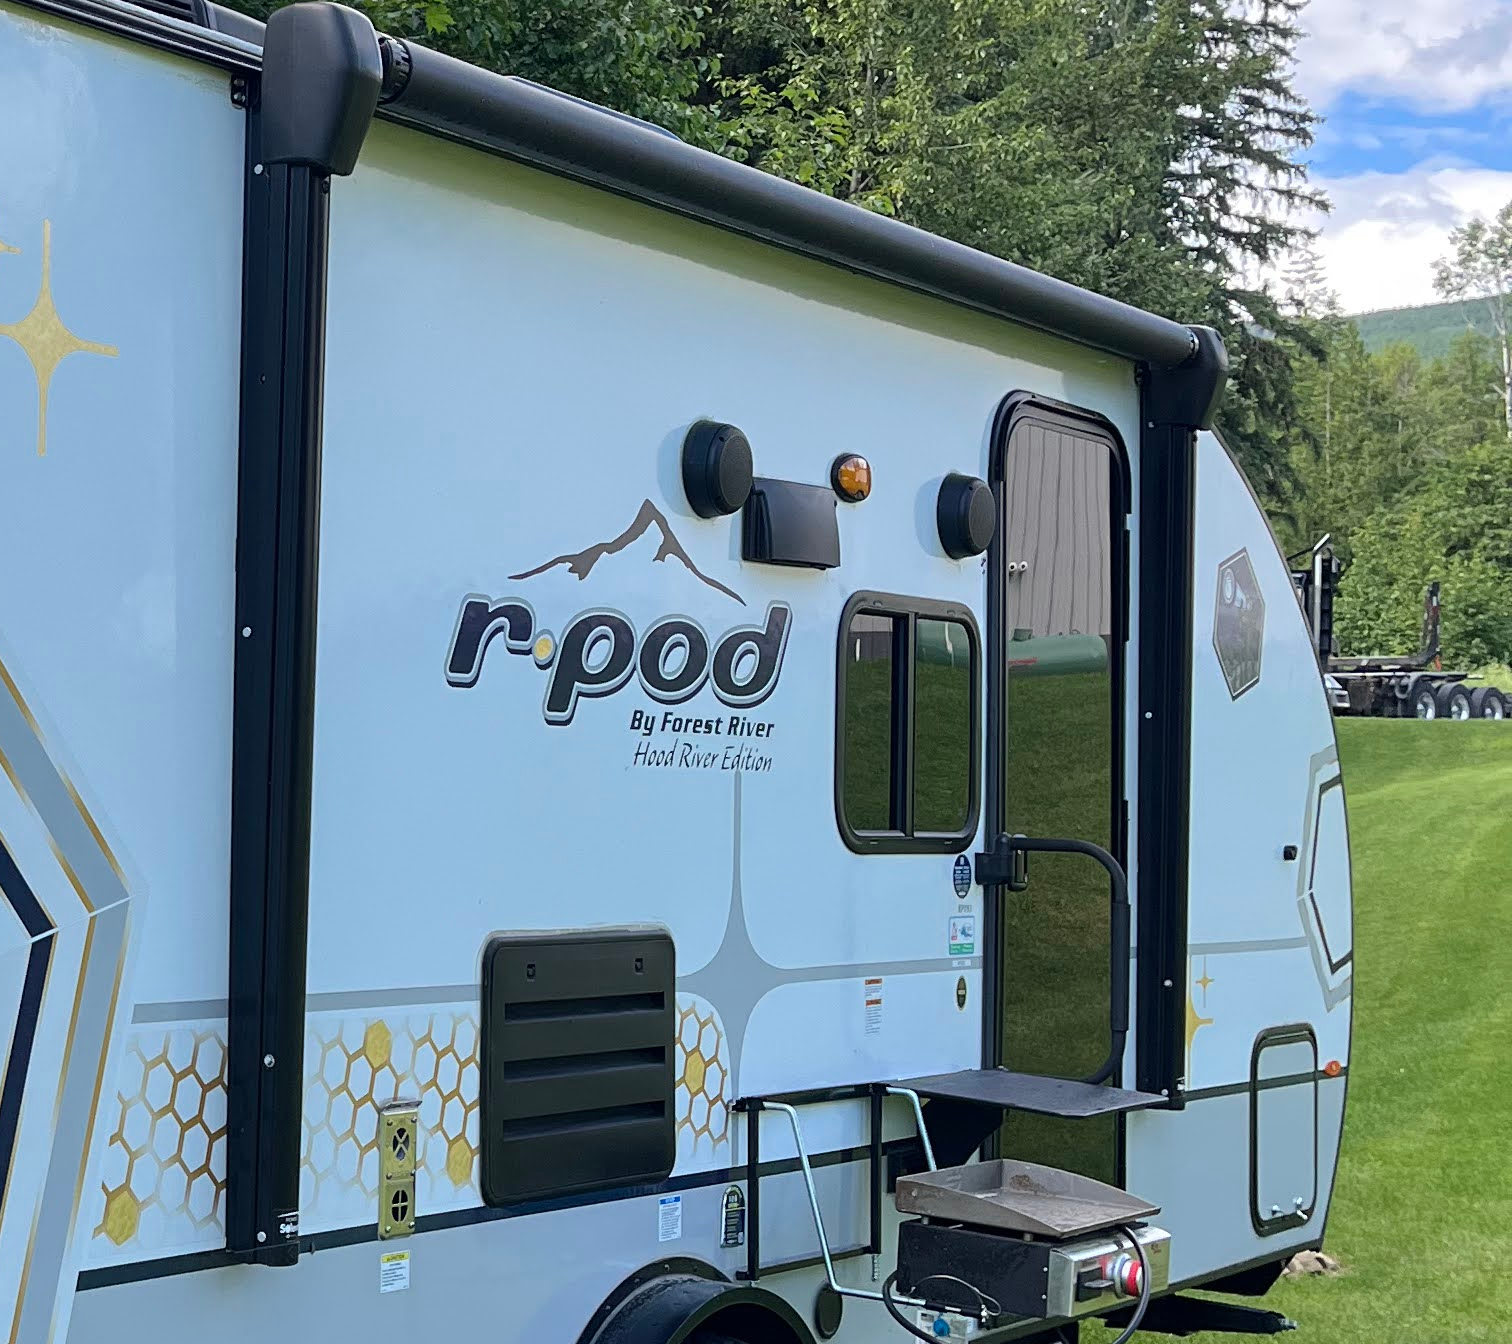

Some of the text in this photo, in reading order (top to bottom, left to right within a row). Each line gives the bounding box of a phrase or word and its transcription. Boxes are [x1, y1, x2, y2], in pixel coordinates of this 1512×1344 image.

[630, 710, 775, 738] By Forest River
[633, 738, 773, 772] Hood River Edition
